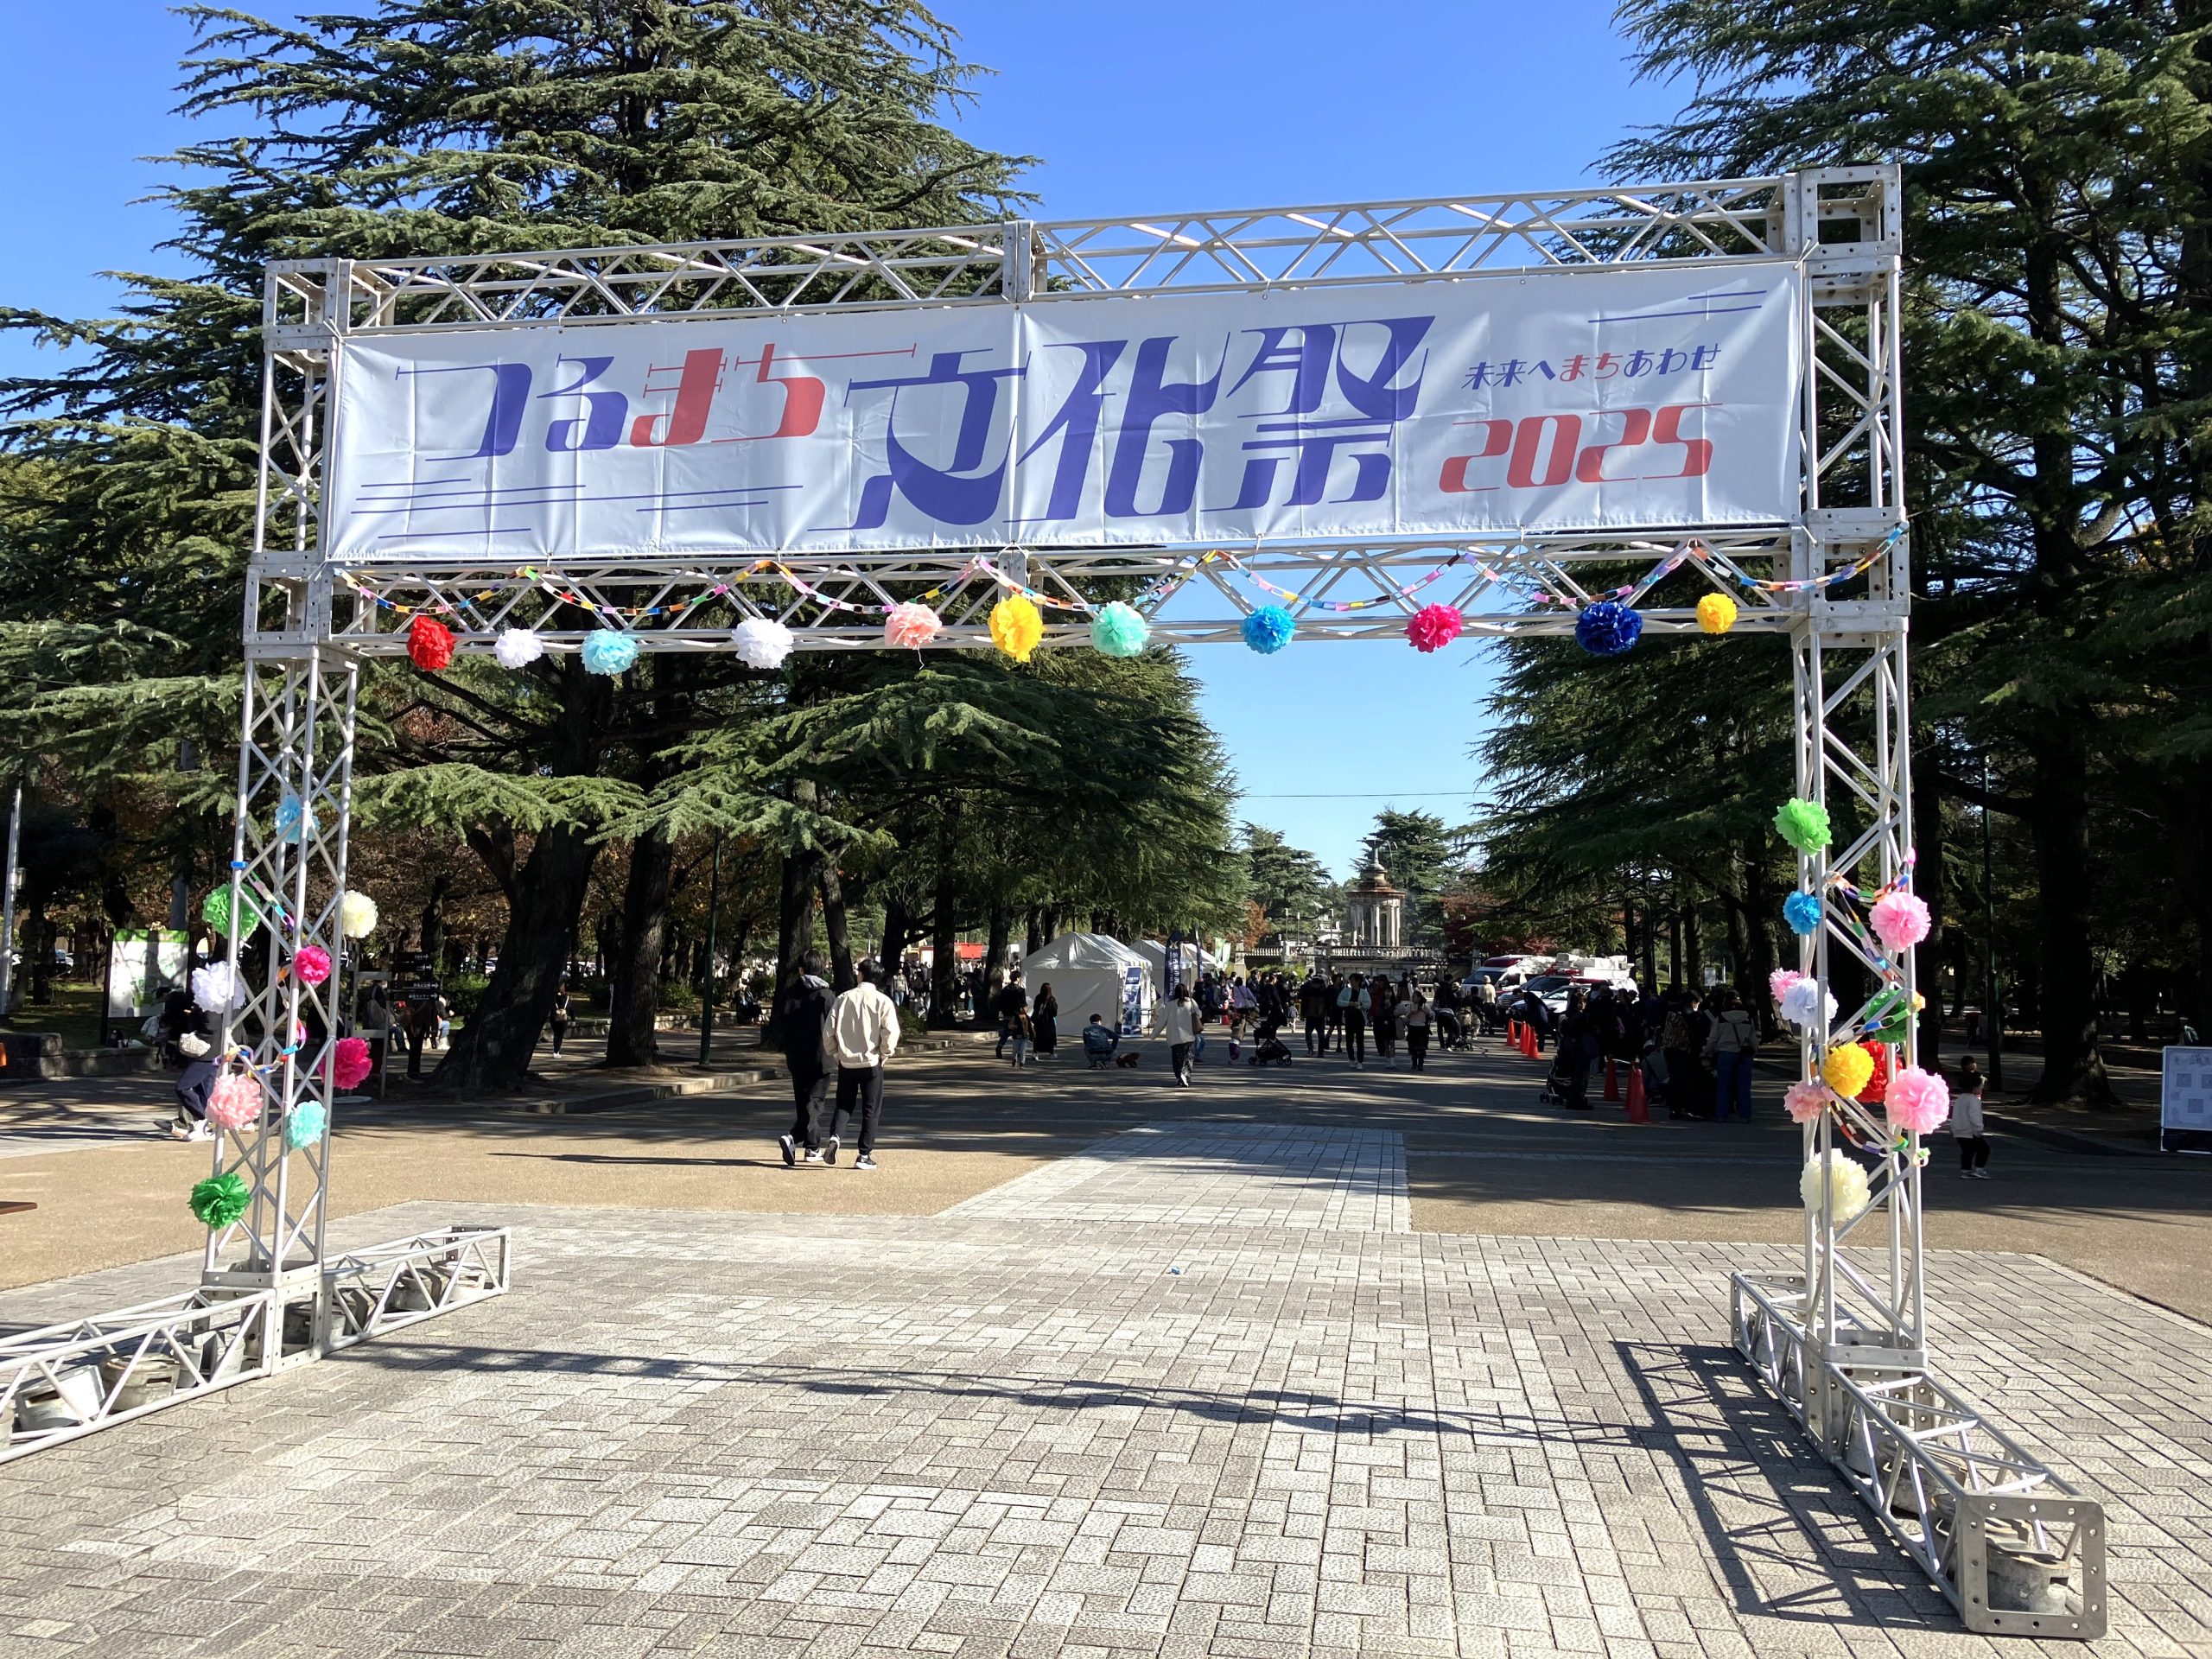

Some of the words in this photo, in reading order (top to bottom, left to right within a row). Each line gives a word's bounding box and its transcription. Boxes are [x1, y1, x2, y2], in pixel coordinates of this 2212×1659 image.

[1461, 343, 1722, 391] 未来へまちあわせ
[396, 316, 1434, 531] つるまち文化祭
[1440, 403, 1723, 493] 2025
